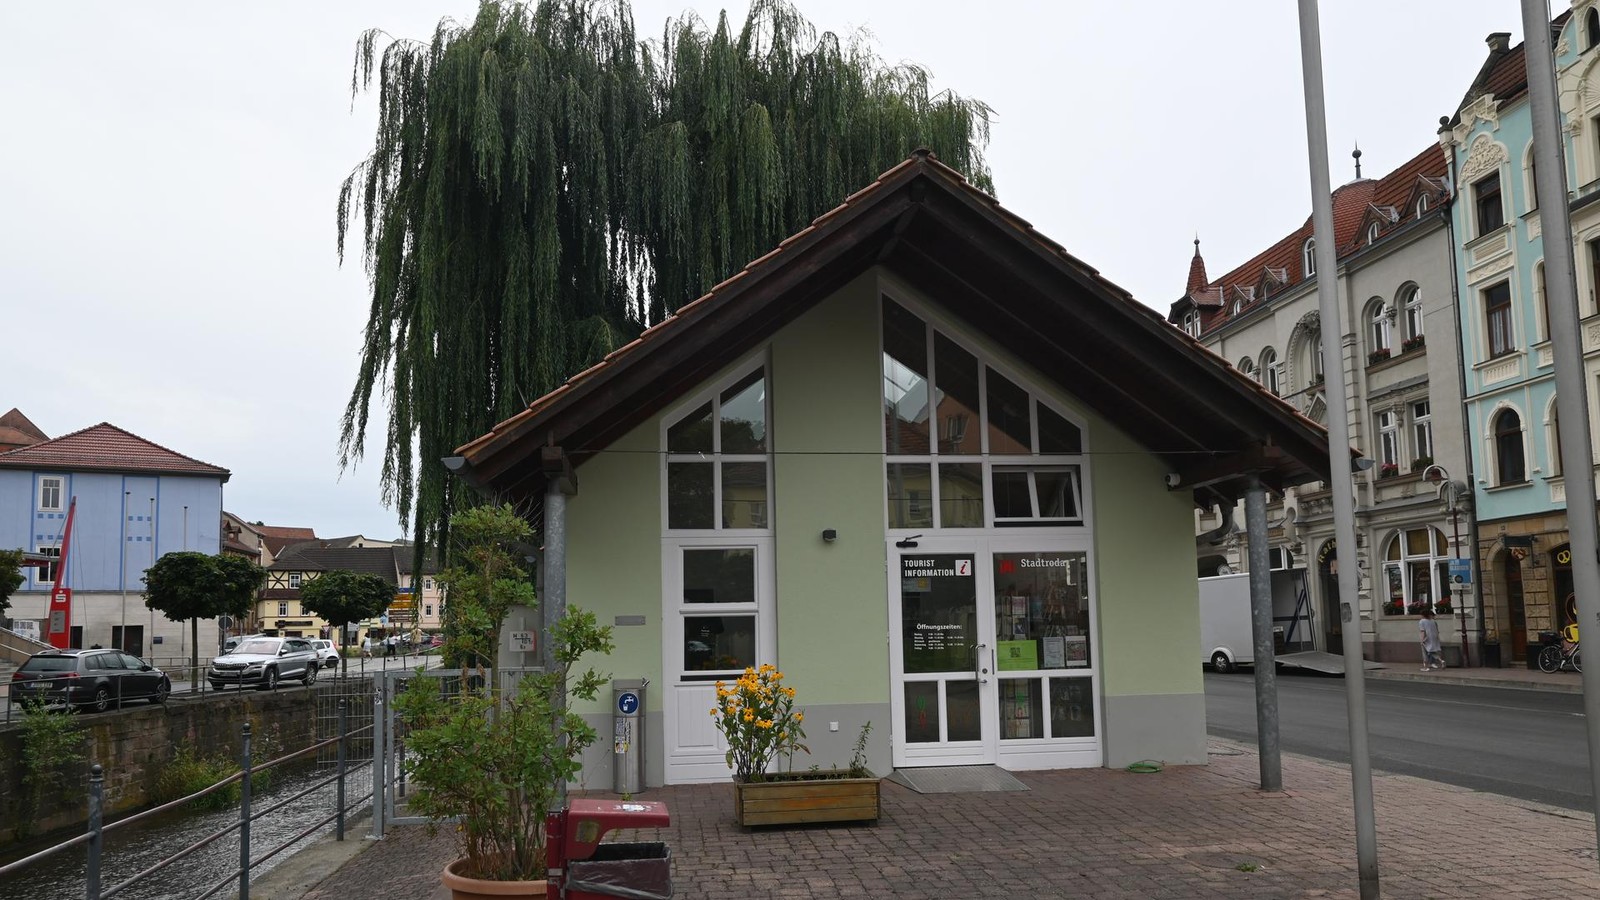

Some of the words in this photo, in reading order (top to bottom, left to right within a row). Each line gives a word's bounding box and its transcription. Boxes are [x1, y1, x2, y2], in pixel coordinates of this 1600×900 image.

[904, 559, 935, 568] TOURIST
[1020, 558, 1066, 568] Stadtroda
[904, 569, 954, 577] INFORMATION
[916, 622, 963, 631] Öffnungszeiten:
